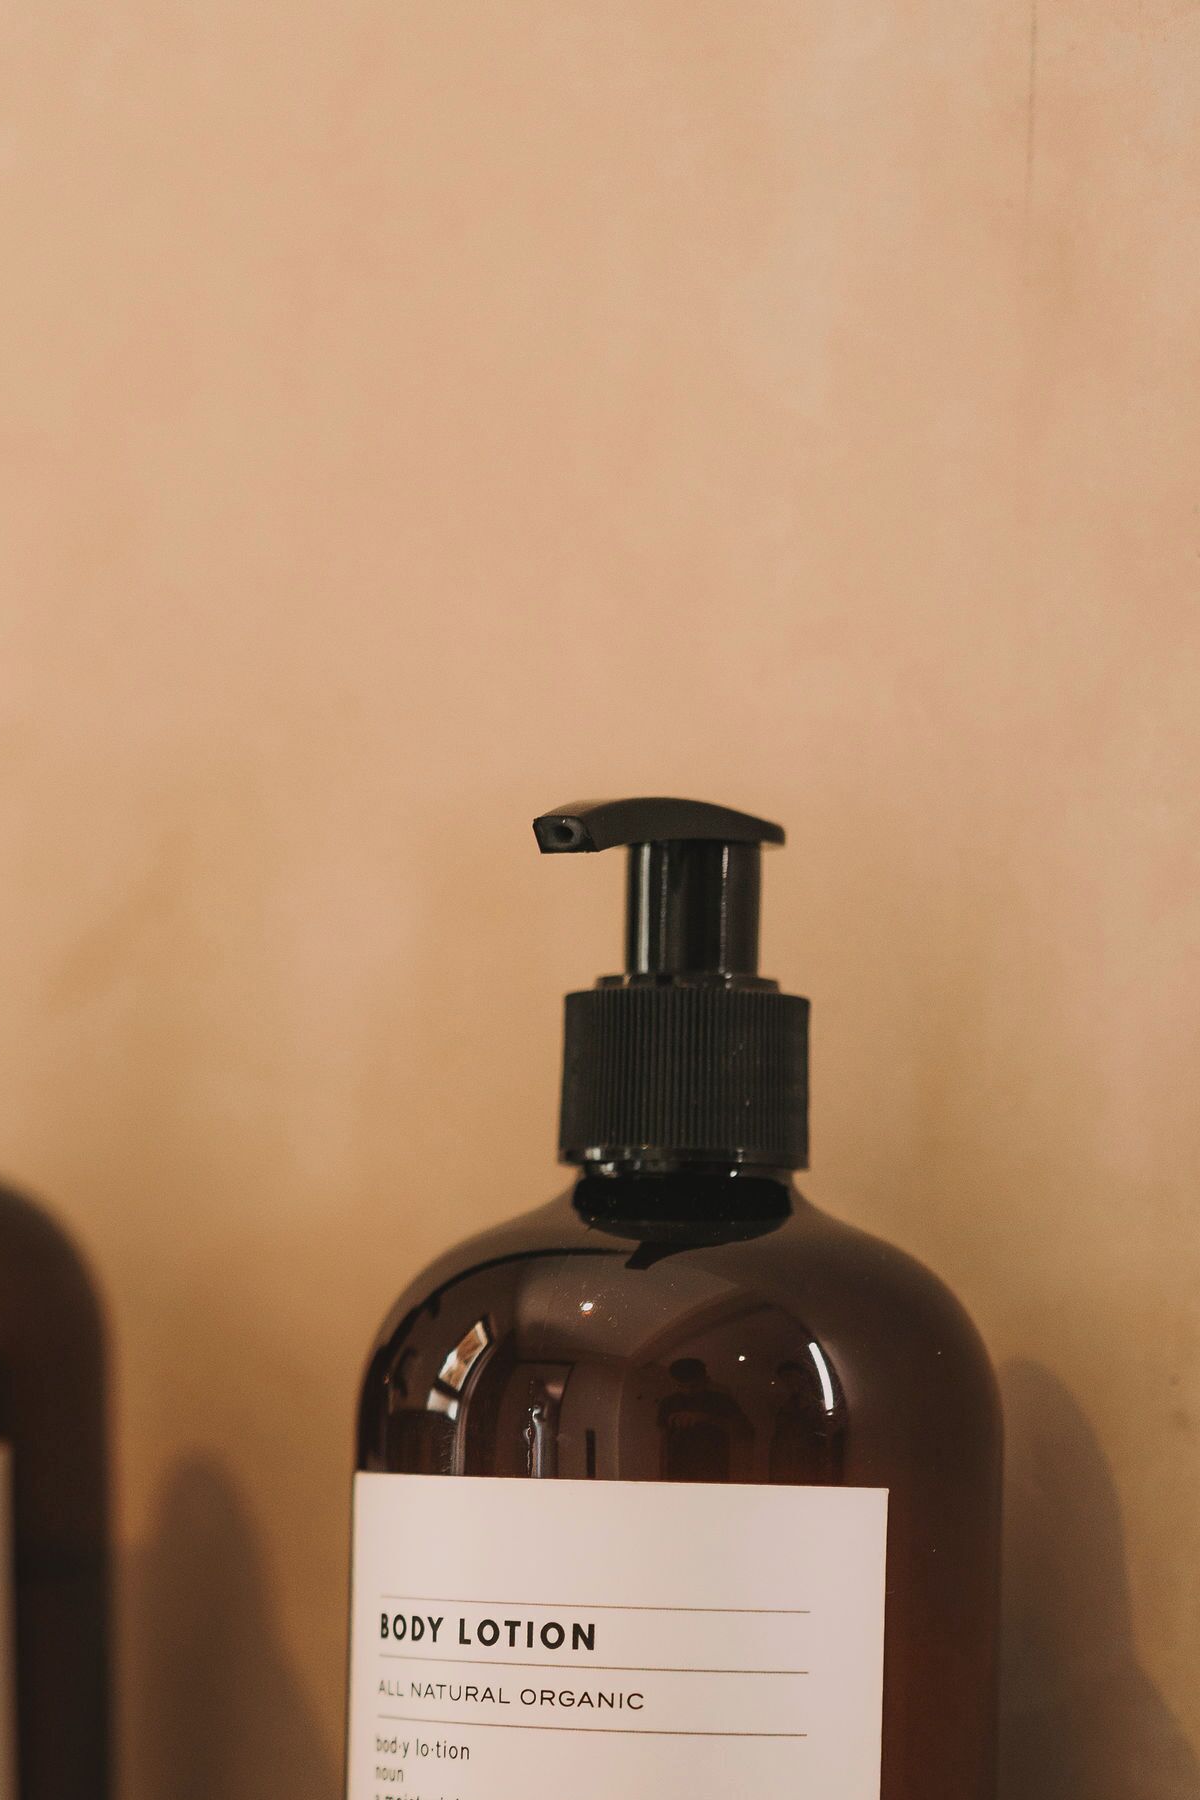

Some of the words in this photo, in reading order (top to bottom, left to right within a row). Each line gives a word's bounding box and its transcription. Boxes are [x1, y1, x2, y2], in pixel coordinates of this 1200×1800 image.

[381, 1613, 443, 1642] BODY
[459, 1618, 595, 1650] LOTION
[378, 1680, 404, 1697] ALL
[410, 1682, 511, 1704] NATURAL
[520, 1688, 645, 1710] ORGANIC
[375, 1766, 404, 1782] noun
